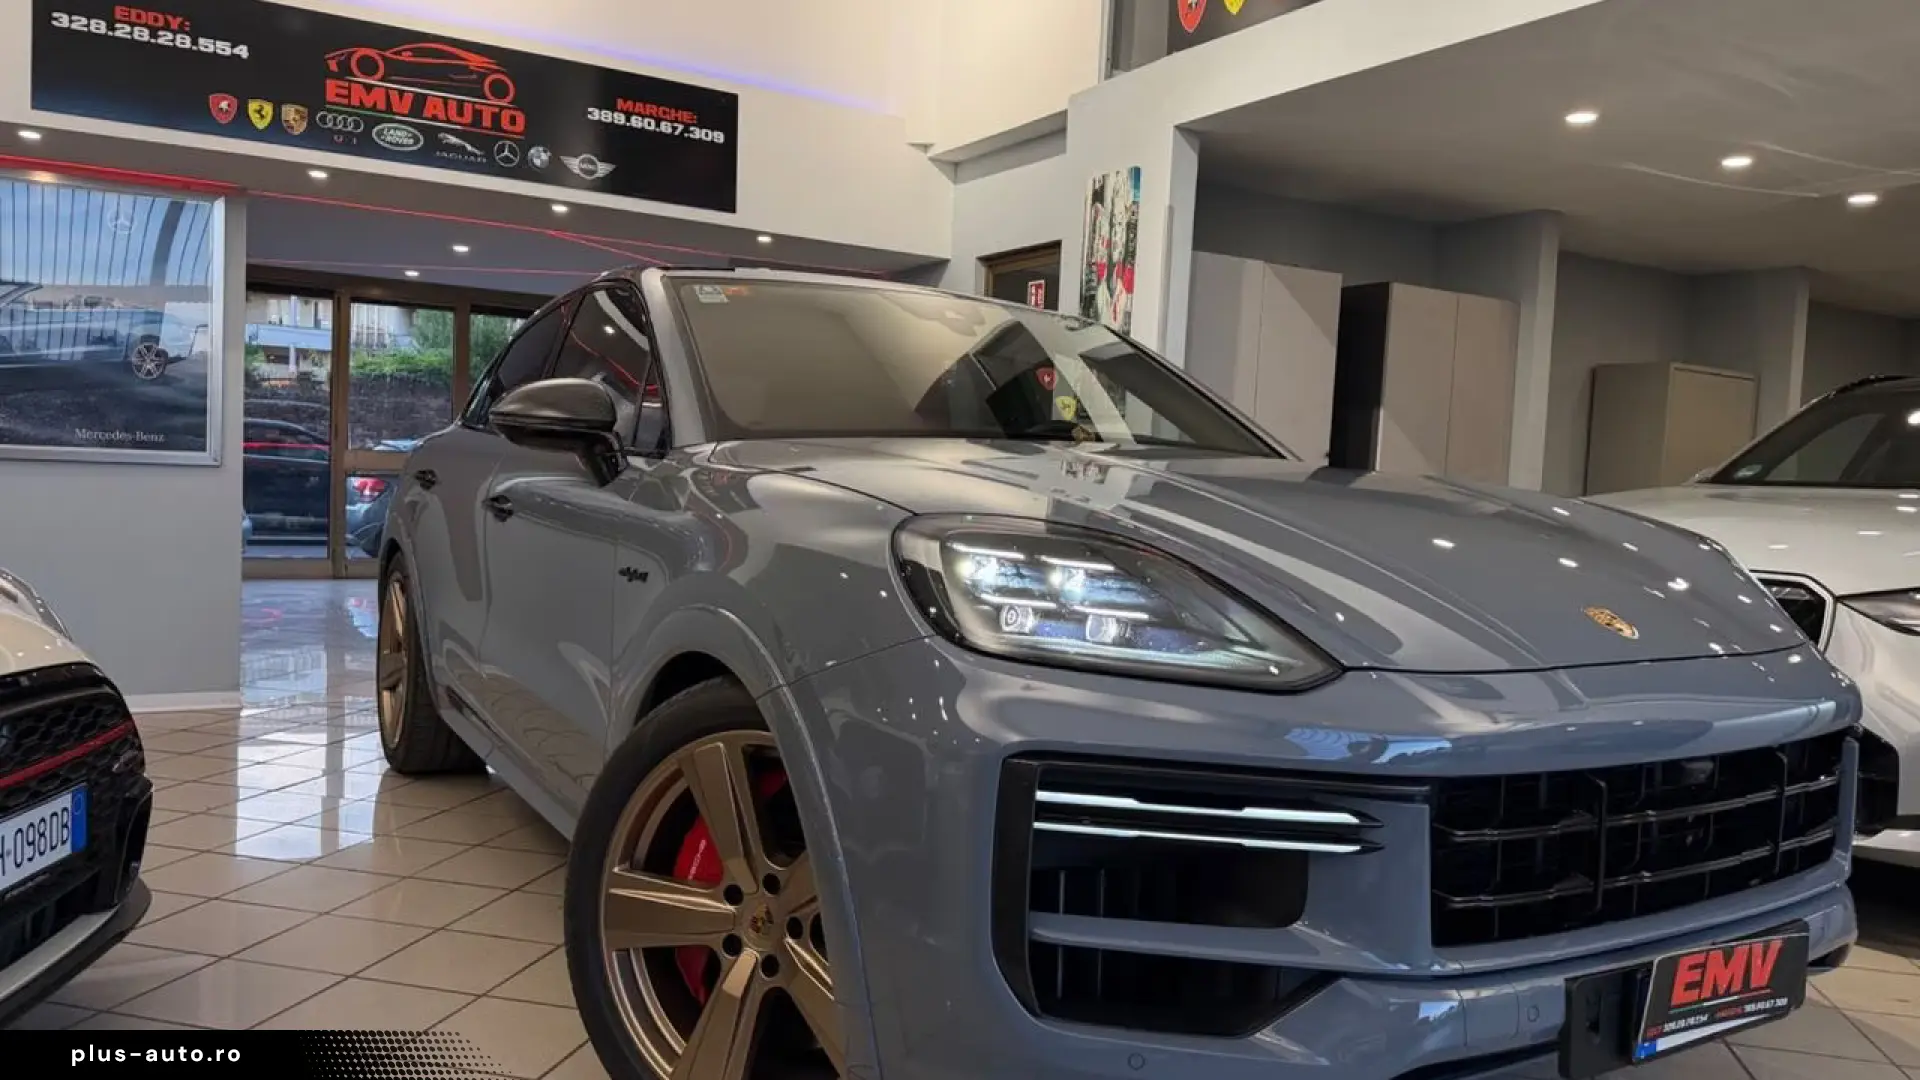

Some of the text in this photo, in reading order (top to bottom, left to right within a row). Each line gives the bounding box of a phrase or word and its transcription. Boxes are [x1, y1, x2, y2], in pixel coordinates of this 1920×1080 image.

[51, 11, 249, 59] 328.28.28.554
[114, 5, 191, 31] EDDY:
[326, 79, 525, 133] EMV AUTO
[616, 98, 697, 124] MARCHE:
[587, 107, 724, 144] 389.60.67.309
[74, 428, 165, 442] Mercedes-Benz
[1671, 940, 1782, 1006] EMV
